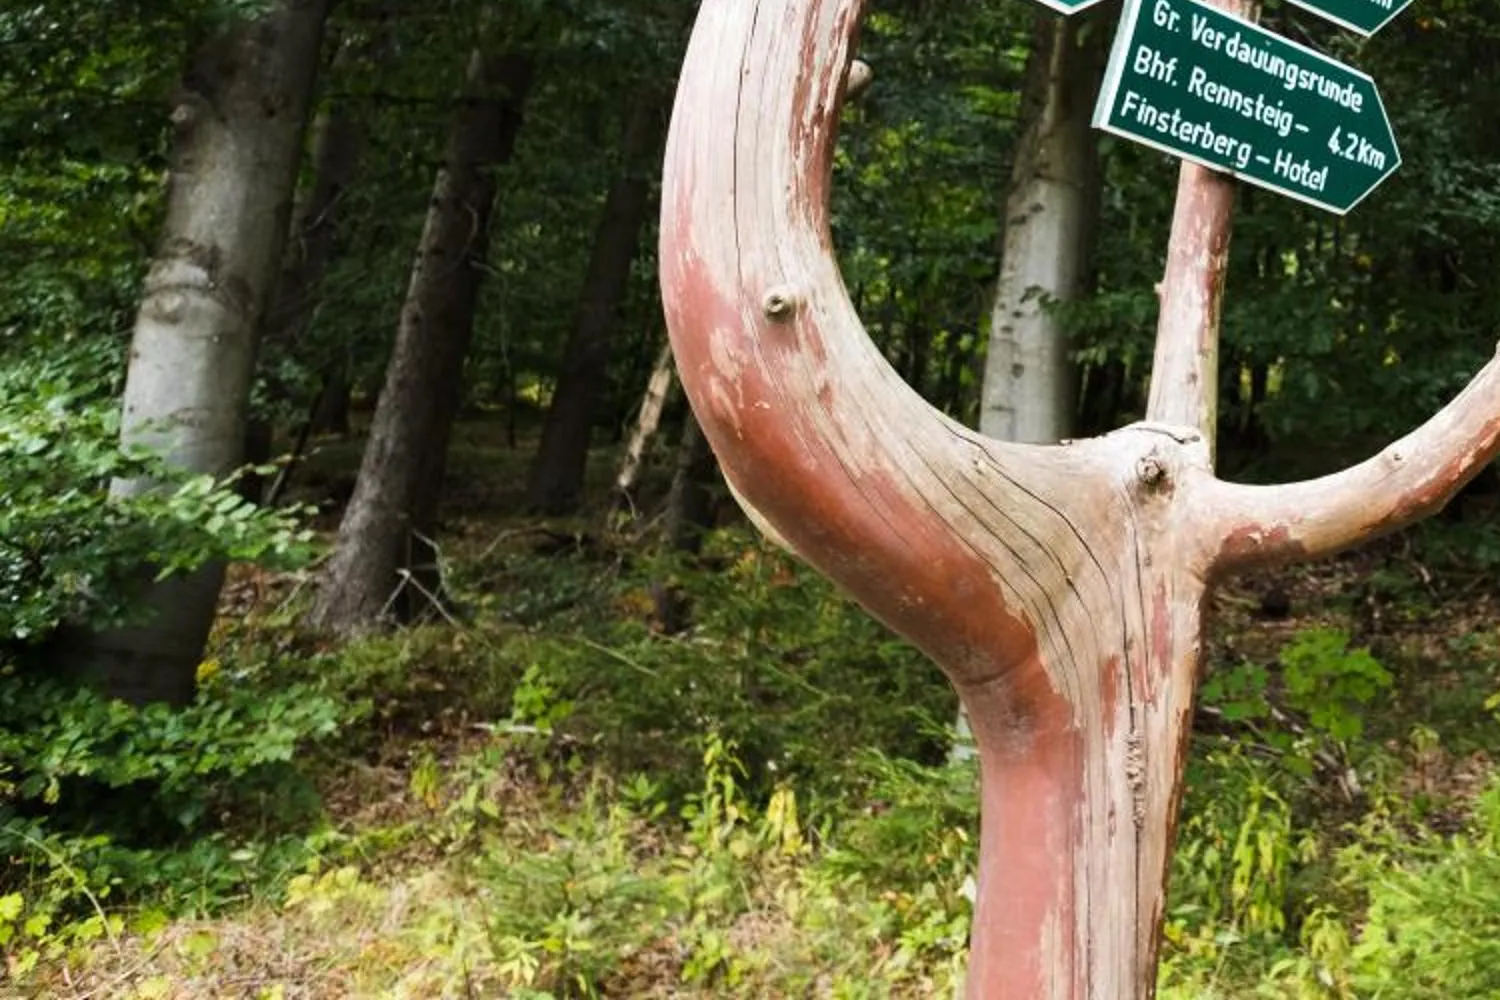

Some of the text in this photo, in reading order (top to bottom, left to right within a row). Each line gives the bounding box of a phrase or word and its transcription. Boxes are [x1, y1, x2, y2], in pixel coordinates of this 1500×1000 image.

[1133, 45, 1178, 87] Bhf.
[1327, 125, 1386, 171] 4.2km
[1191, 12, 1364, 113] Verdauungsrunde
